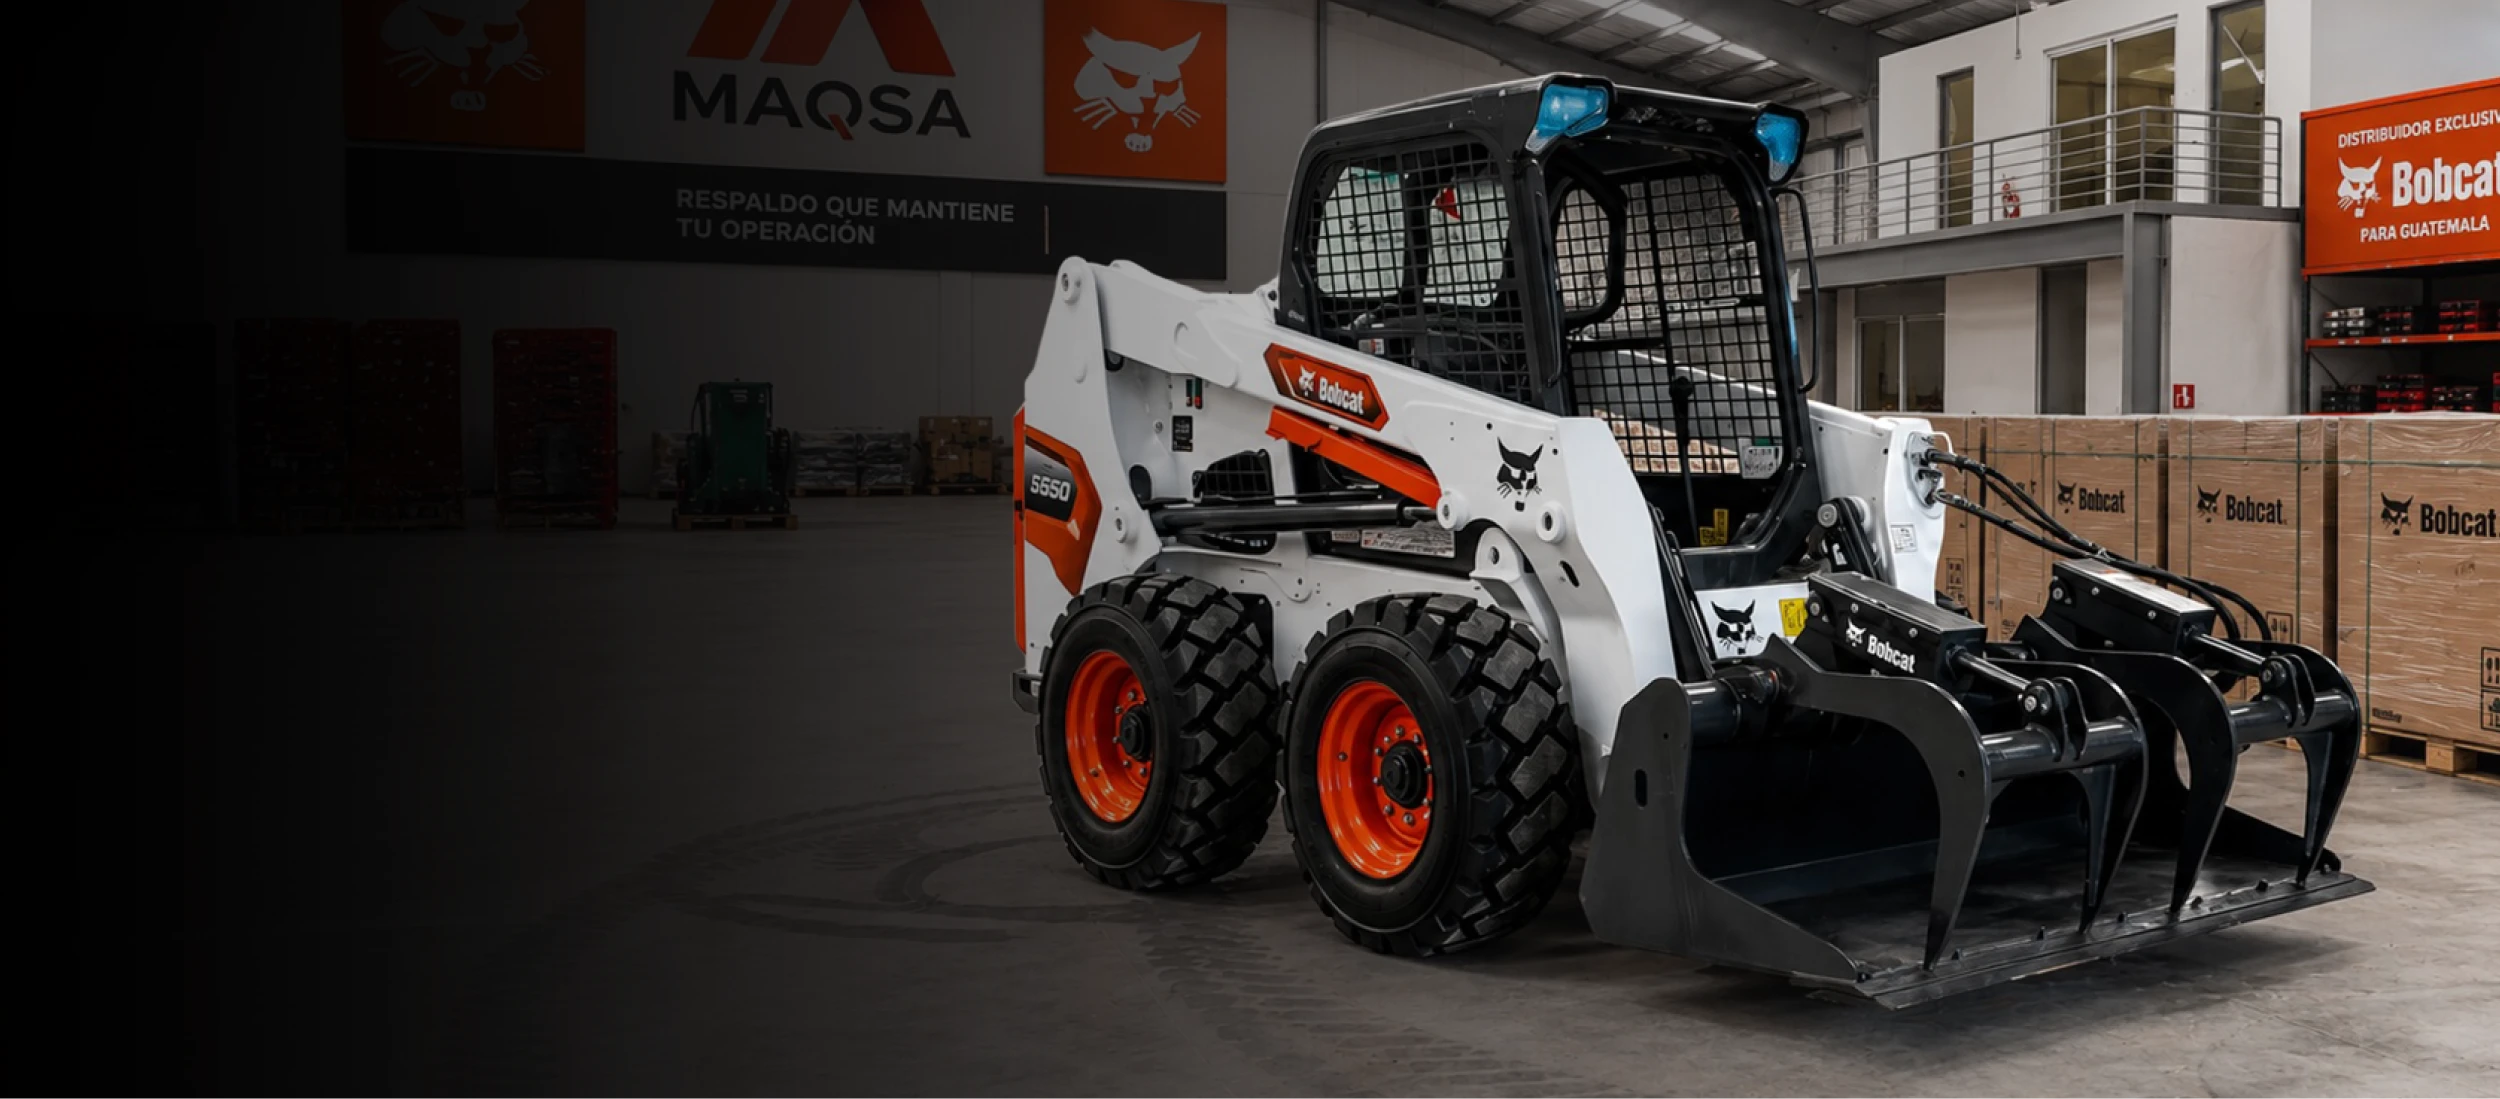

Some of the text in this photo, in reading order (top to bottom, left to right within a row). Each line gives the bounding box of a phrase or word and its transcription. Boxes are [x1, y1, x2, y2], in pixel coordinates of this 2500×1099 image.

[674, 70, 971, 140] MAQSA
[2338, 120, 2431, 148] DISTRIBUIDOR
[676, 188, 1015, 223] RESPALDO QUE MANTIENE
[676, 217, 875, 245] TU OPERACIÓN
[2360, 215, 2490, 243] PARA GUATEMALA
[1319, 377, 1364, 415] Bobcat
[2078, 488, 2126, 514] Bobcat
[2225, 494, 2283, 525] Bobcat
[2420, 503, 2497, 538] Bobcat
[1867, 634, 1916, 674] Bobcat
